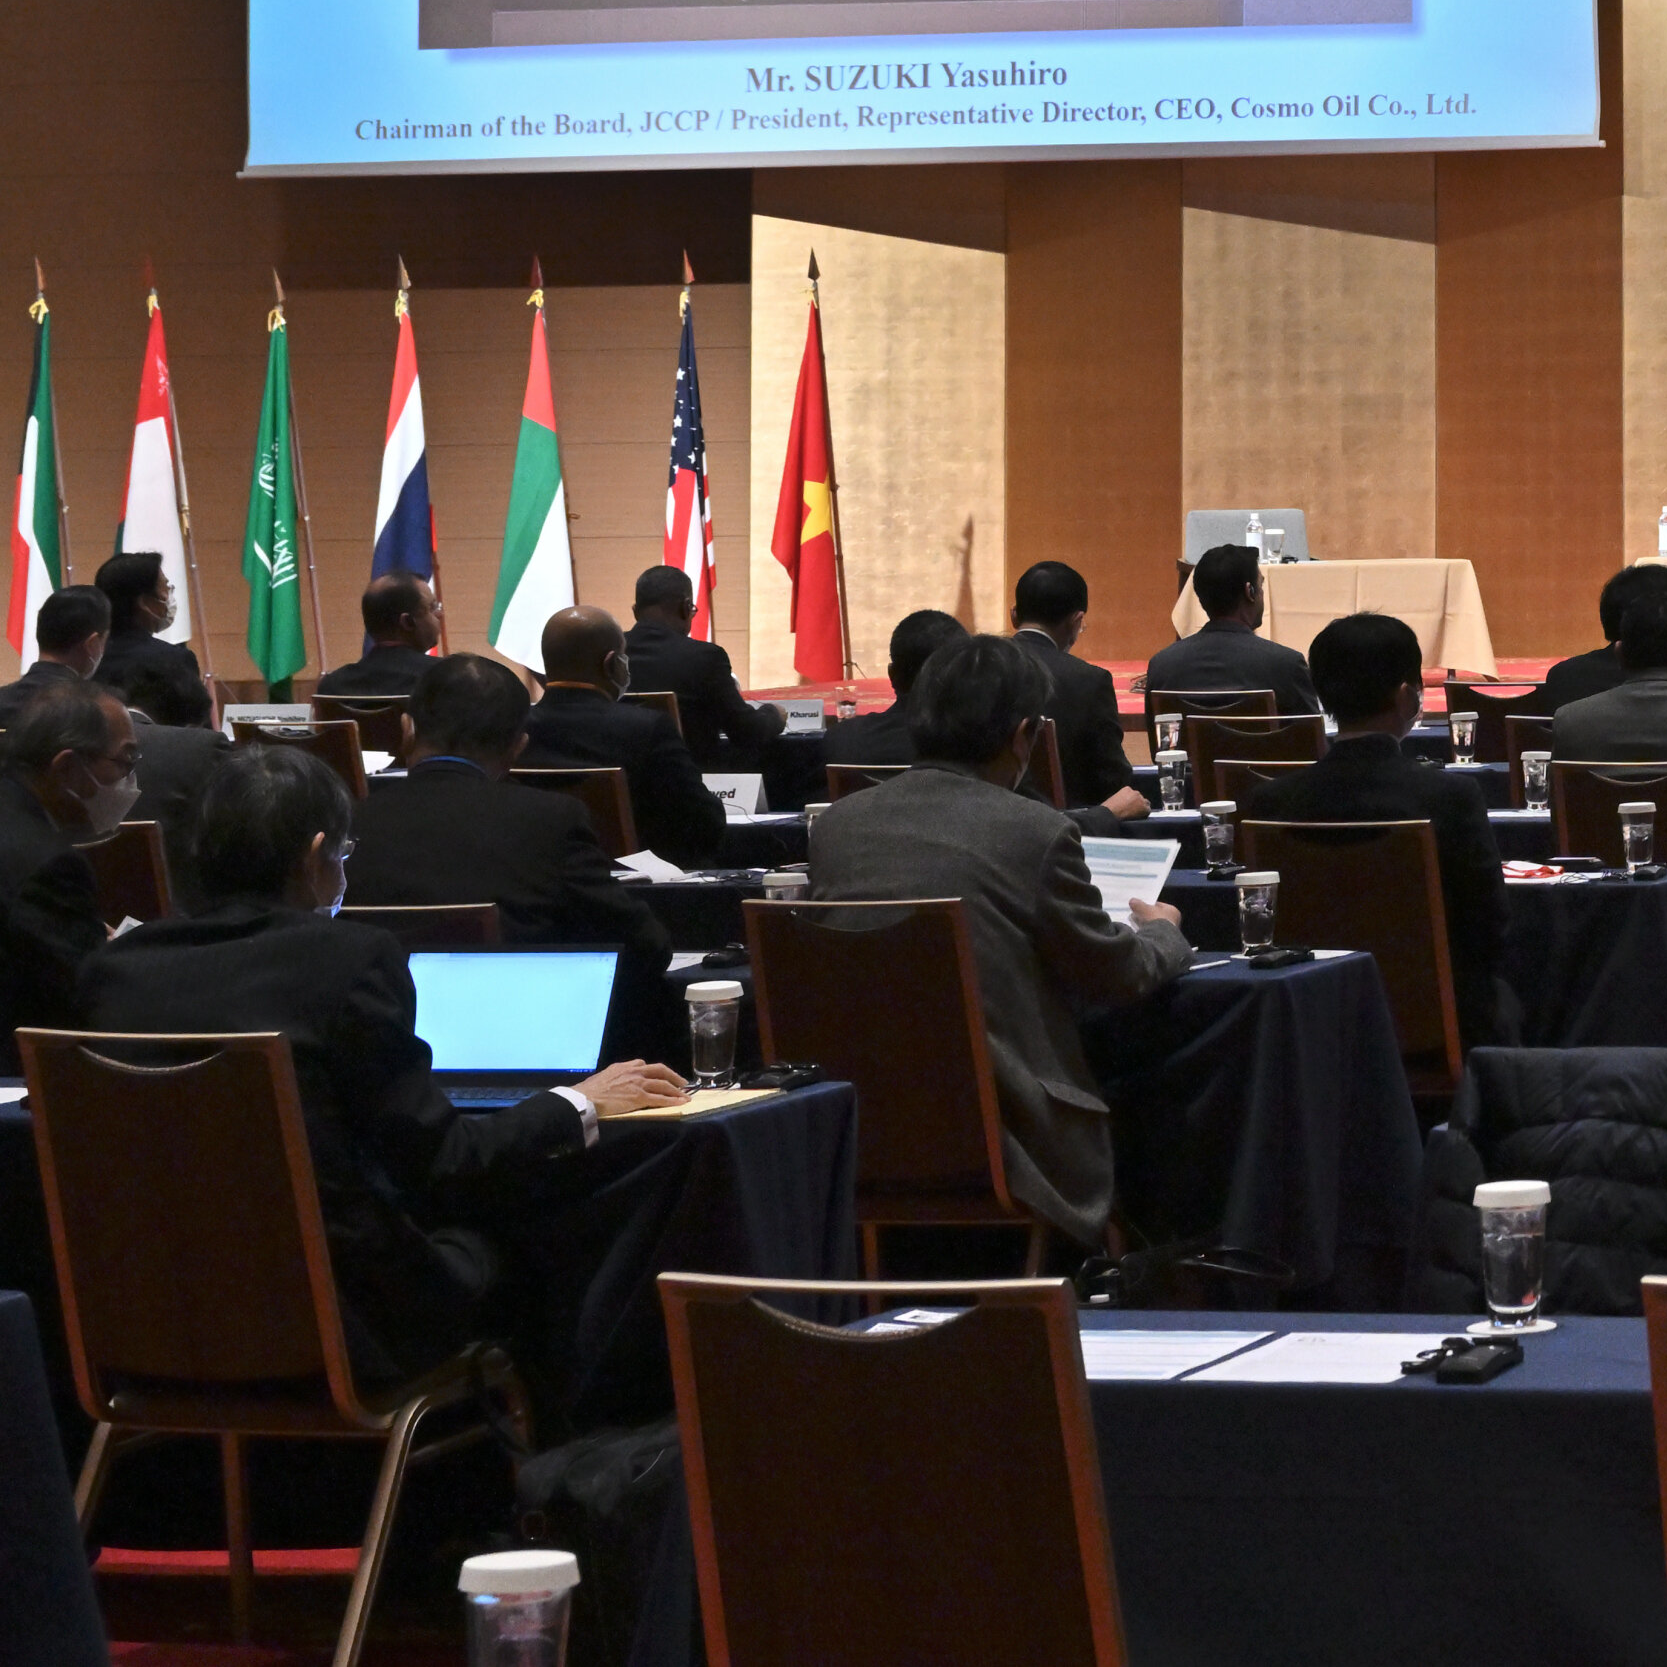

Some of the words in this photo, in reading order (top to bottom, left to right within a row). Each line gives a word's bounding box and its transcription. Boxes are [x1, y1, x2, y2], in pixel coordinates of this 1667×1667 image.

[746, 67, 795, 93] Mr.
[805, 63, 932, 92] SUZUKI
[940, 60, 1067, 88] Yasuhiro
[355, 118, 472, 142] Chairman
[480, 115, 506, 137] of
[510, 115, 546, 136] the
[553, 112, 633, 138] Board,
[640, 110, 710, 132] JCCP
[730, 107, 848, 132] President,
[856, 102, 1034, 132] Representative
[1040, 101, 1147, 126] Director,
[1153, 98, 1223, 124] CEO,
[1230, 97, 1314, 118] Cosmo
[1321, 95, 1360, 118] Oil
[1368, 94, 1417, 120] Co.,
[1425, 93, 1476, 115] Ltd.
